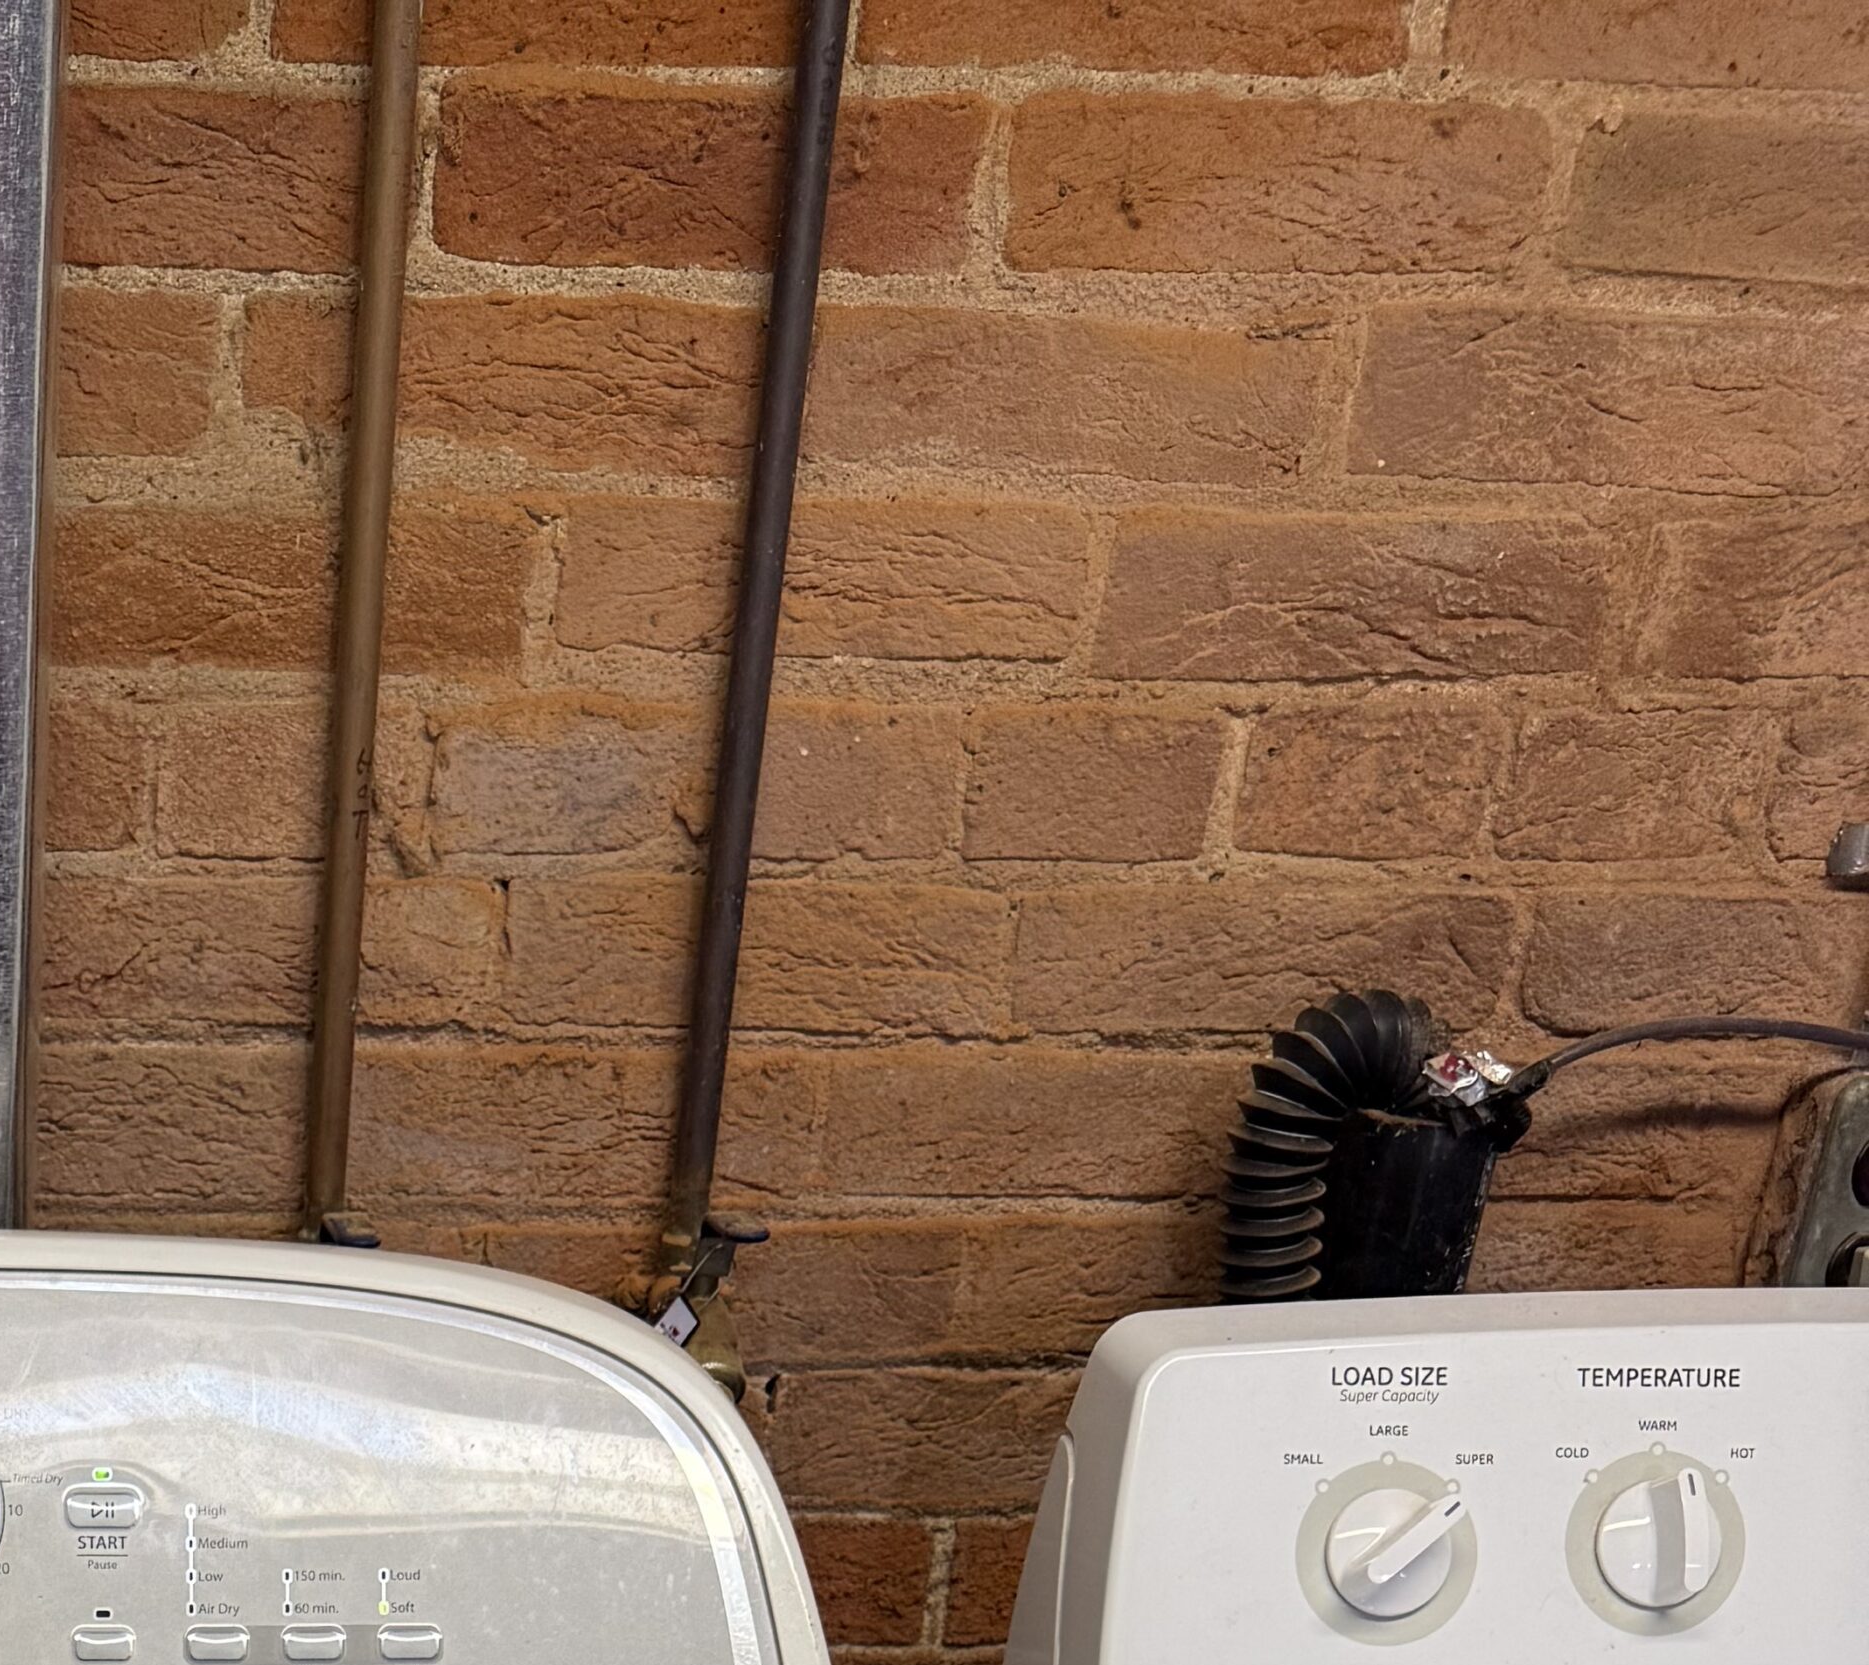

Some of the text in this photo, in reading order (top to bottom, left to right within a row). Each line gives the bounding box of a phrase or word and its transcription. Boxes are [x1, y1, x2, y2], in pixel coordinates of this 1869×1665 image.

[1331, 1366, 1449, 1388] LOAD SIZE
[1577, 1367, 1741, 1389] TEMPERATURE
[1339, 1388, 1439, 1406] Super Capacity
[1368, 1425, 1409, 1438] LARGE
[1638, 1419, 1678, 1432] WARM
[1455, 1453, 1494, 1466] SUPER
[1555, 1447, 1590, 1459] COLD
[1730, 1447, 1756, 1460] HOT
[1283, 1454, 1324, 1466] SMALL
[13, 1472, 64, 1487] Timed Dry
[8, 1504, 24, 1517] 10
[198, 1504, 227, 1519] High
[77, 1535, 128, 1550] START
[198, 1537, 249, 1550] Medium
[87, 1559, 118, 1571] Pause
[198, 1570, 223, 1582] Low
[294, 1569, 346, 1582] 150 min.
[390, 1568, 421, 1582] Loud
[198, 1603, 240, 1618] Air Dry
[294, 1602, 339, 1615] 60 min.
[390, 1601, 415, 1615] Soft
